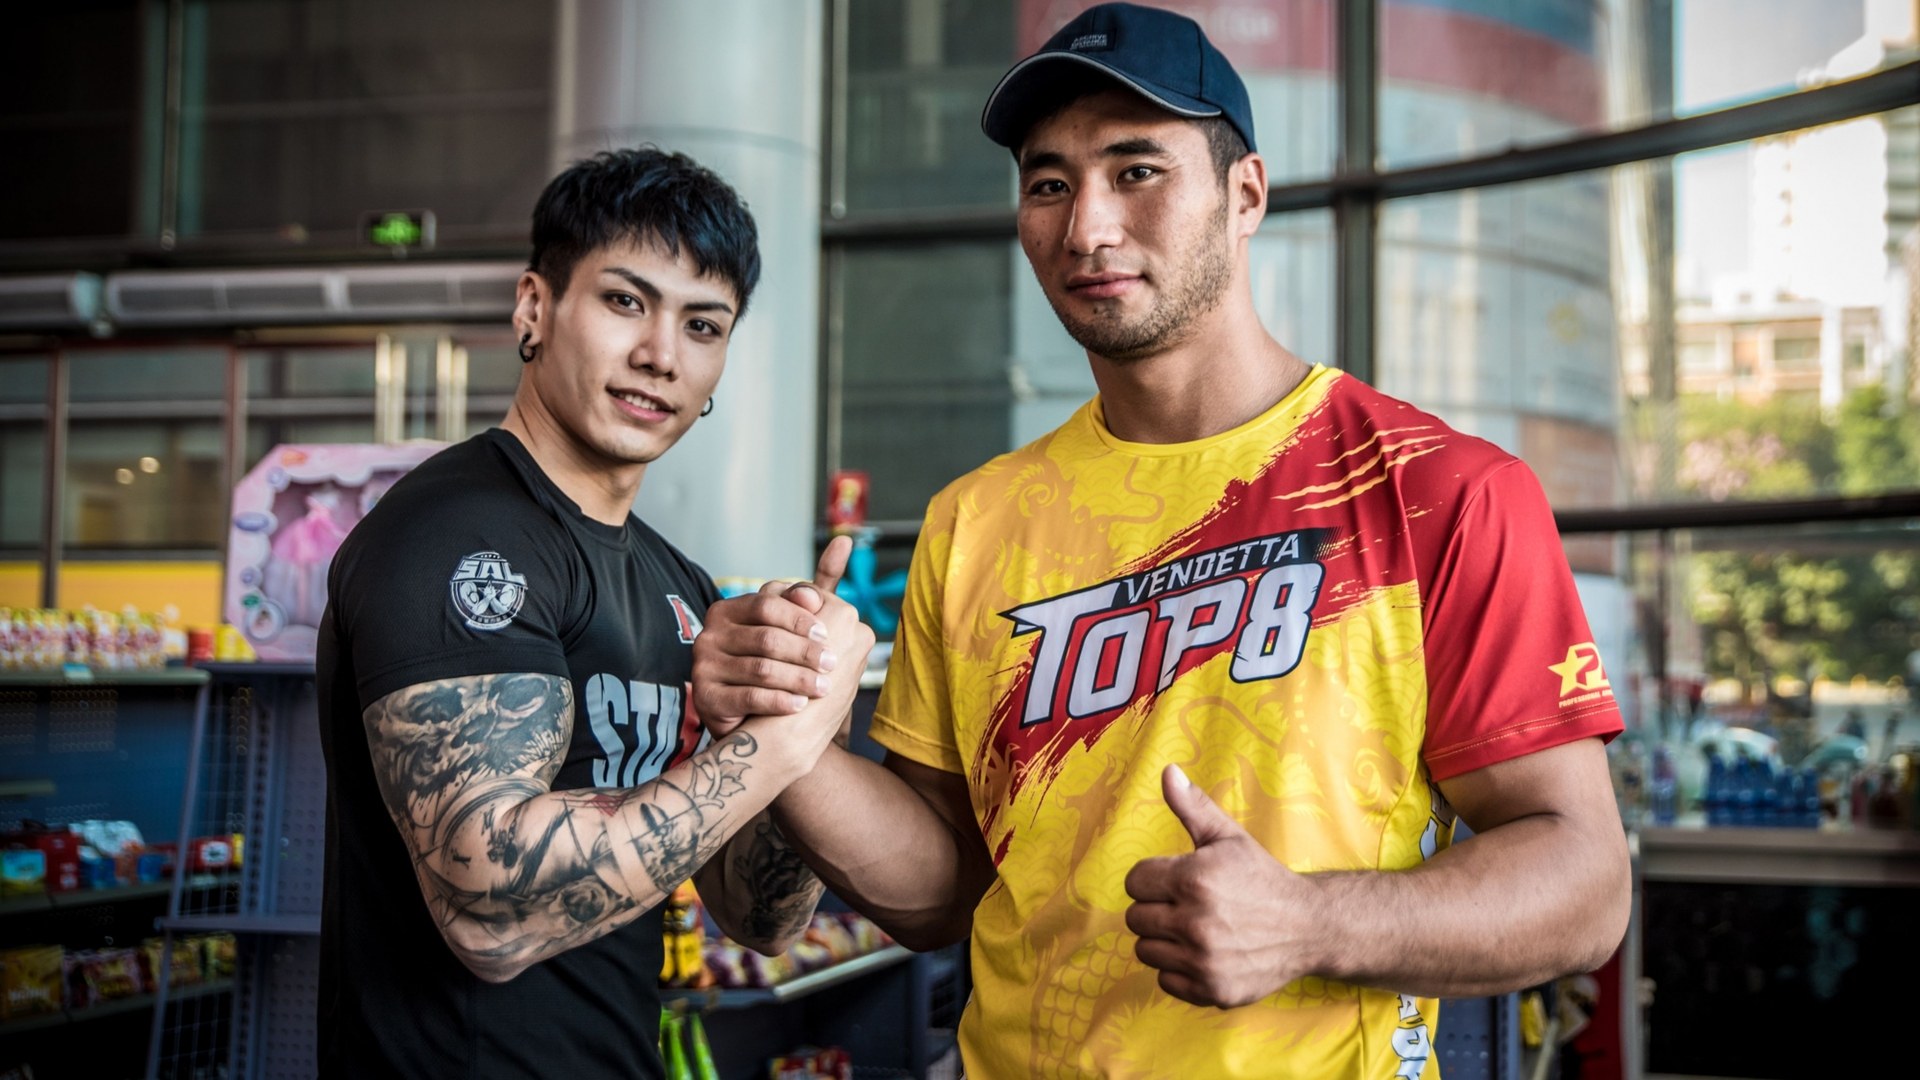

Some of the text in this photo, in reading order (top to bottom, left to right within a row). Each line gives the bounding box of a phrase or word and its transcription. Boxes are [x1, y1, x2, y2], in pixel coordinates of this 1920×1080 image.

[452, 558, 527, 586] SAL
[1122, 532, 1301, 605] VENDETTA
[998, 562, 1326, 730] TOP8
